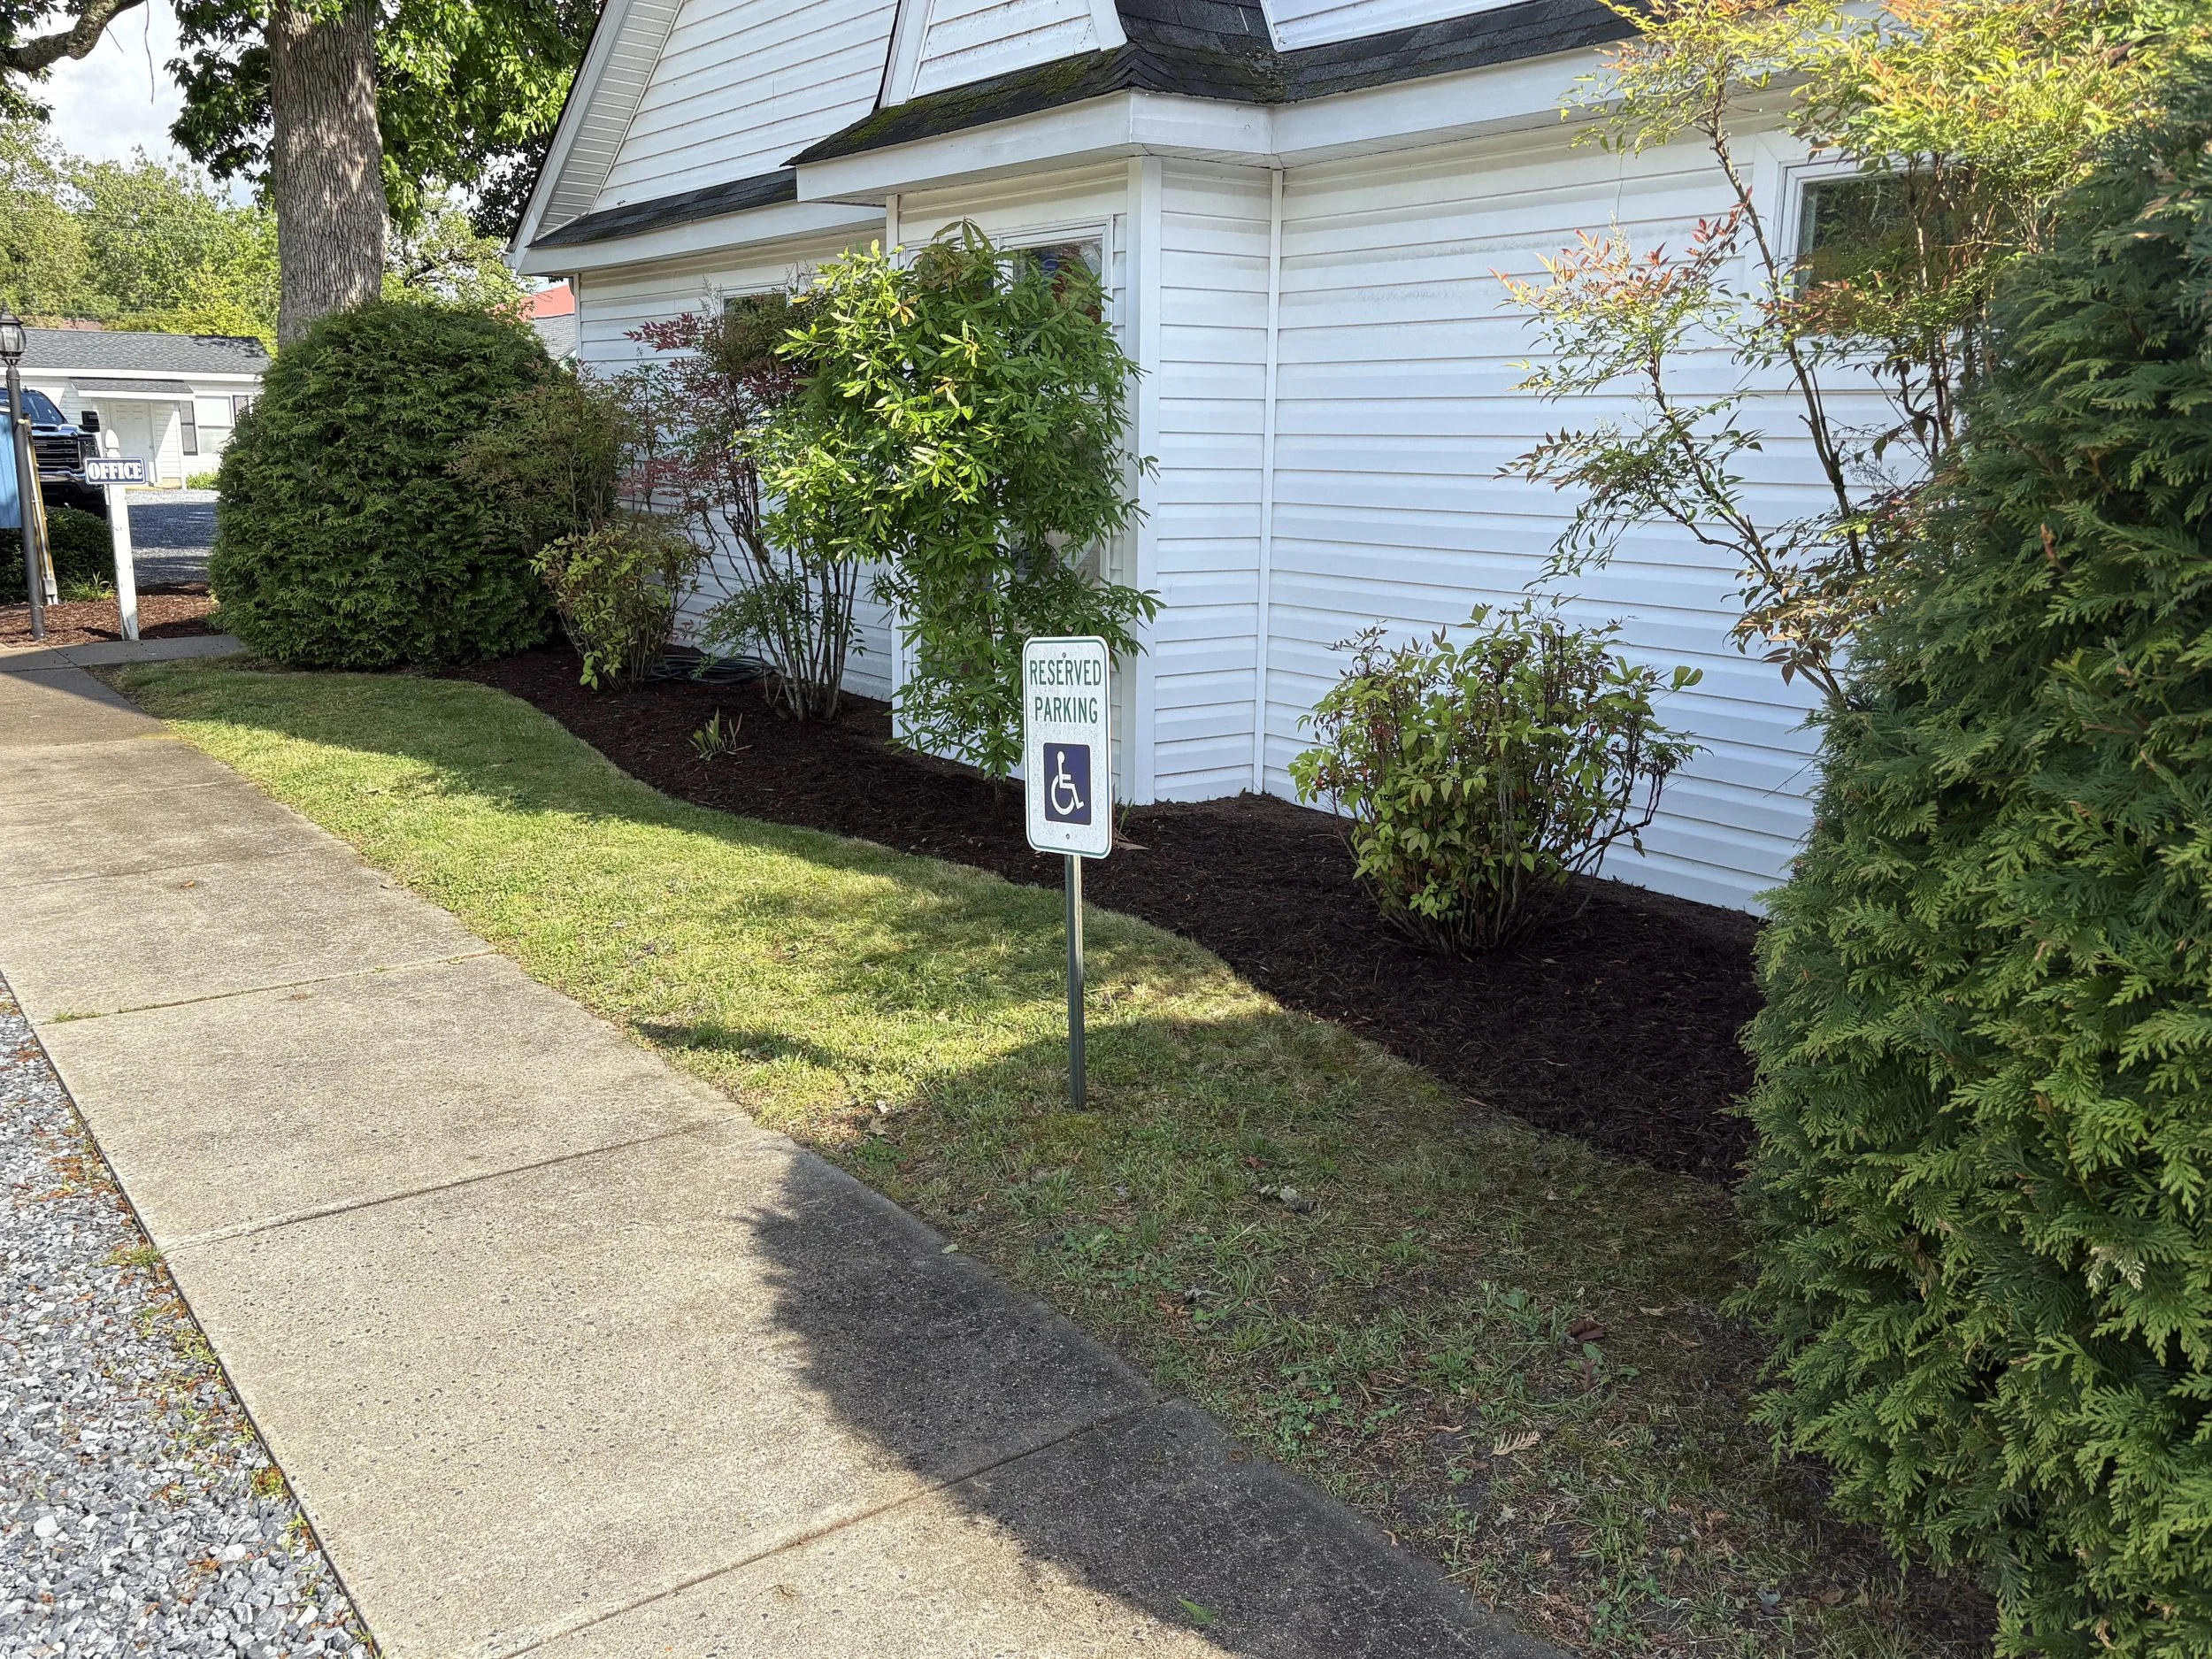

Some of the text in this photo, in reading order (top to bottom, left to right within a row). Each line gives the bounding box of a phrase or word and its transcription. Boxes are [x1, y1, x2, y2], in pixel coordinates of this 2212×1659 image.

[88, 462, 142, 480] OFFICE
[1030, 659, 1102, 686] RESERVED
[1034, 696, 1098, 724] PARKING
